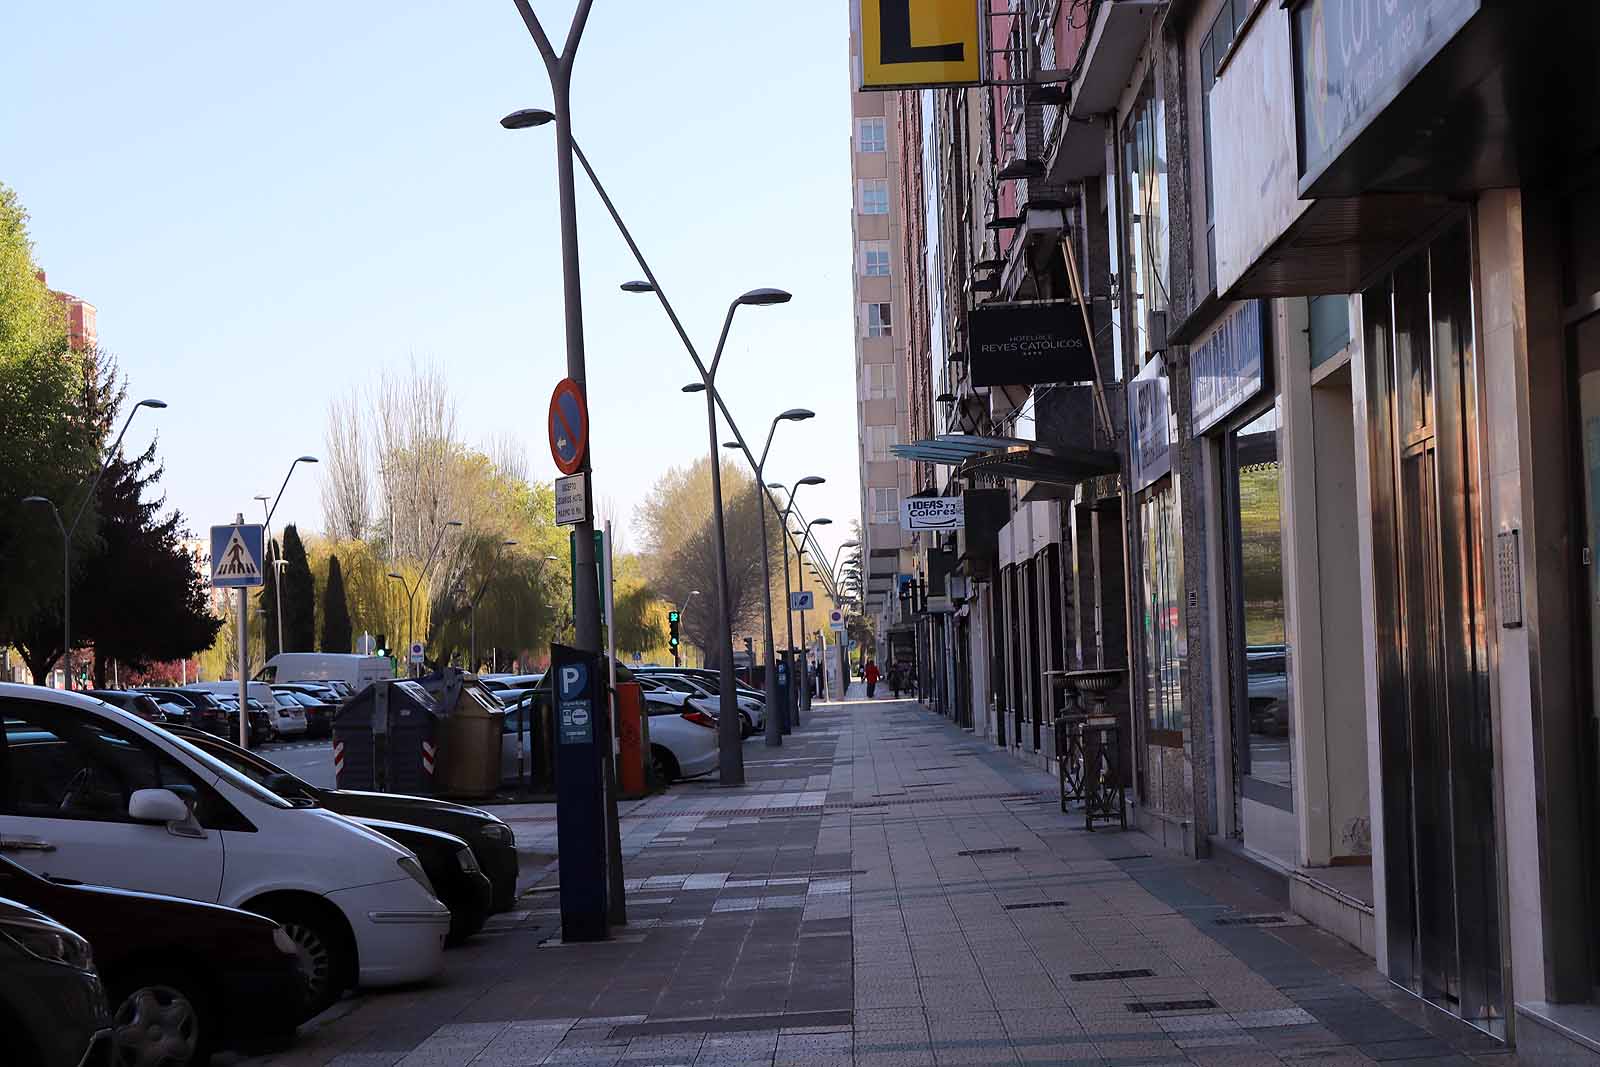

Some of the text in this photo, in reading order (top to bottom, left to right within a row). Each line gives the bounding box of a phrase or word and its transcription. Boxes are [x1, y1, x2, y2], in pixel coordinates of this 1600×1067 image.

[981, 343, 1018, 353] REYES
[912, 500, 944, 509] IDEAS
[910, 509, 956, 517] Colores
[562, 667, 579, 693] P
